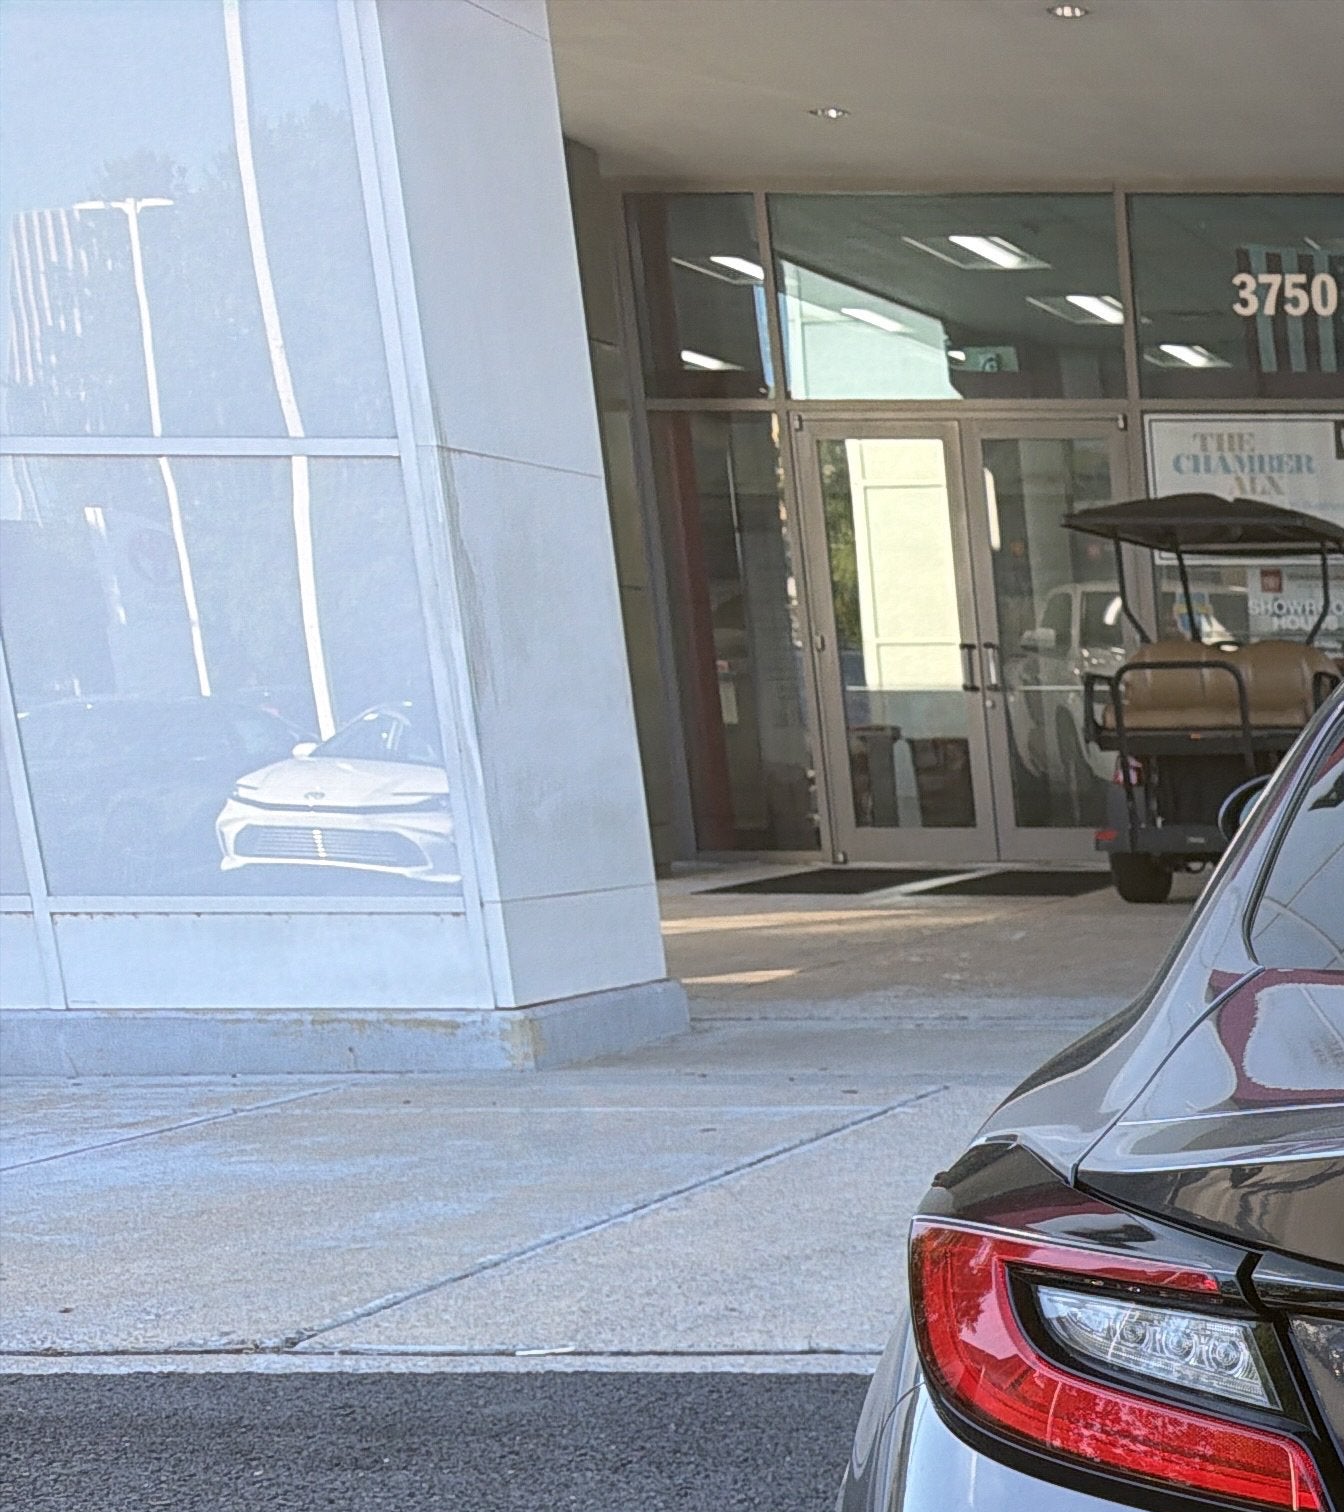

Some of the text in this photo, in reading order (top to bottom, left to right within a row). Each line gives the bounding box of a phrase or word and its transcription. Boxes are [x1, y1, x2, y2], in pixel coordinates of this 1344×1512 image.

[1232, 272, 1338, 316] 3750
[1193, 432, 1255, 452] THE
[1172, 452, 1315, 475] CHAMBER
